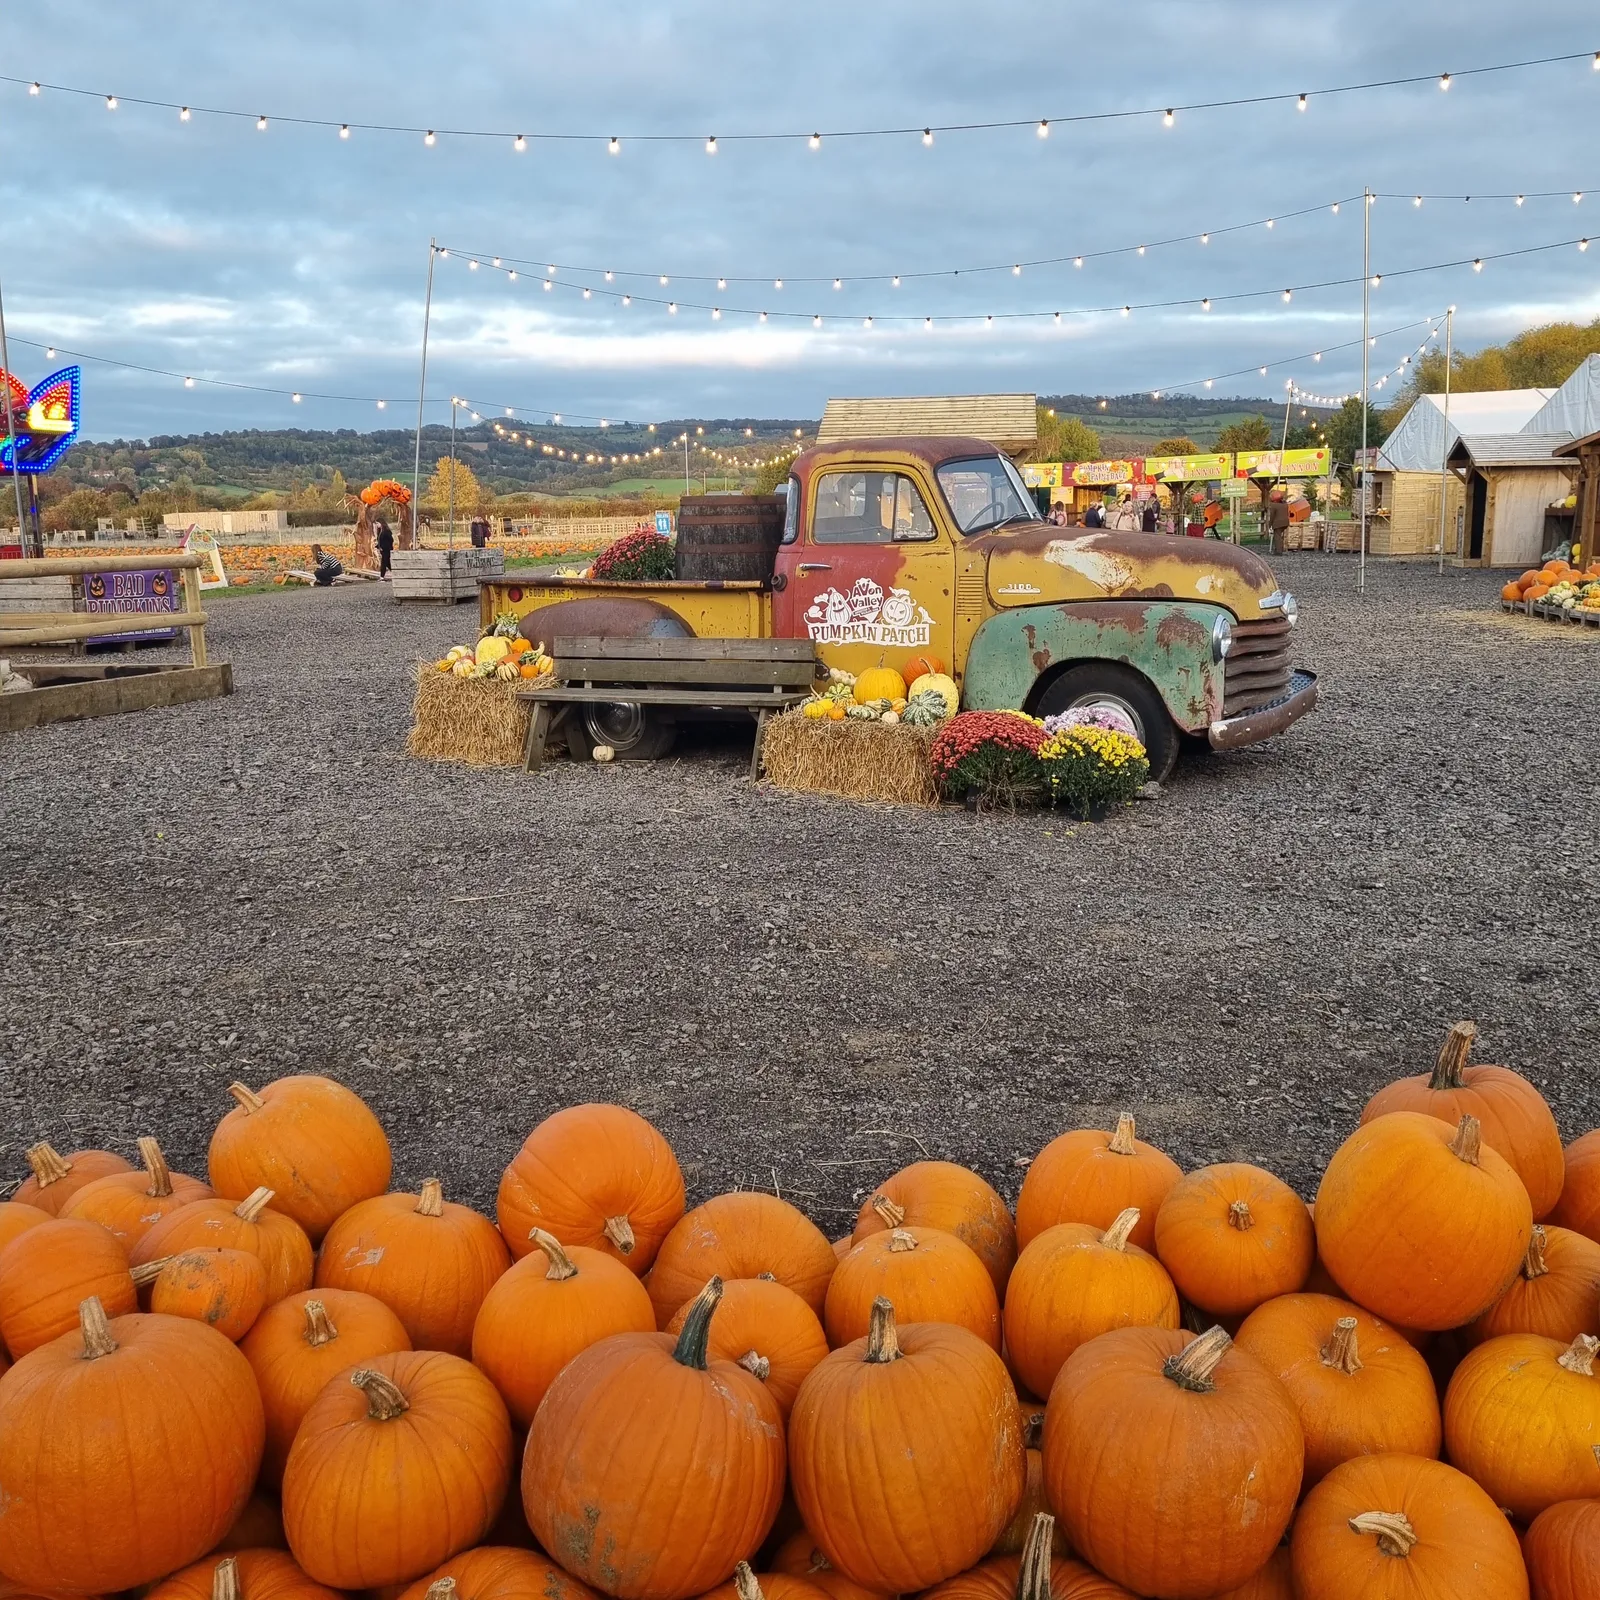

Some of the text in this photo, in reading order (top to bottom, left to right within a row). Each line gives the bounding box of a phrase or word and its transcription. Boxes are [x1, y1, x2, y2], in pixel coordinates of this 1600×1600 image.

[113, 574, 144, 597] BAD
[87, 596, 171, 613] PUMPKINS
[851, 596, 883, 608] Valley
[811, 623, 927, 644] PUMPKIN PATCH
